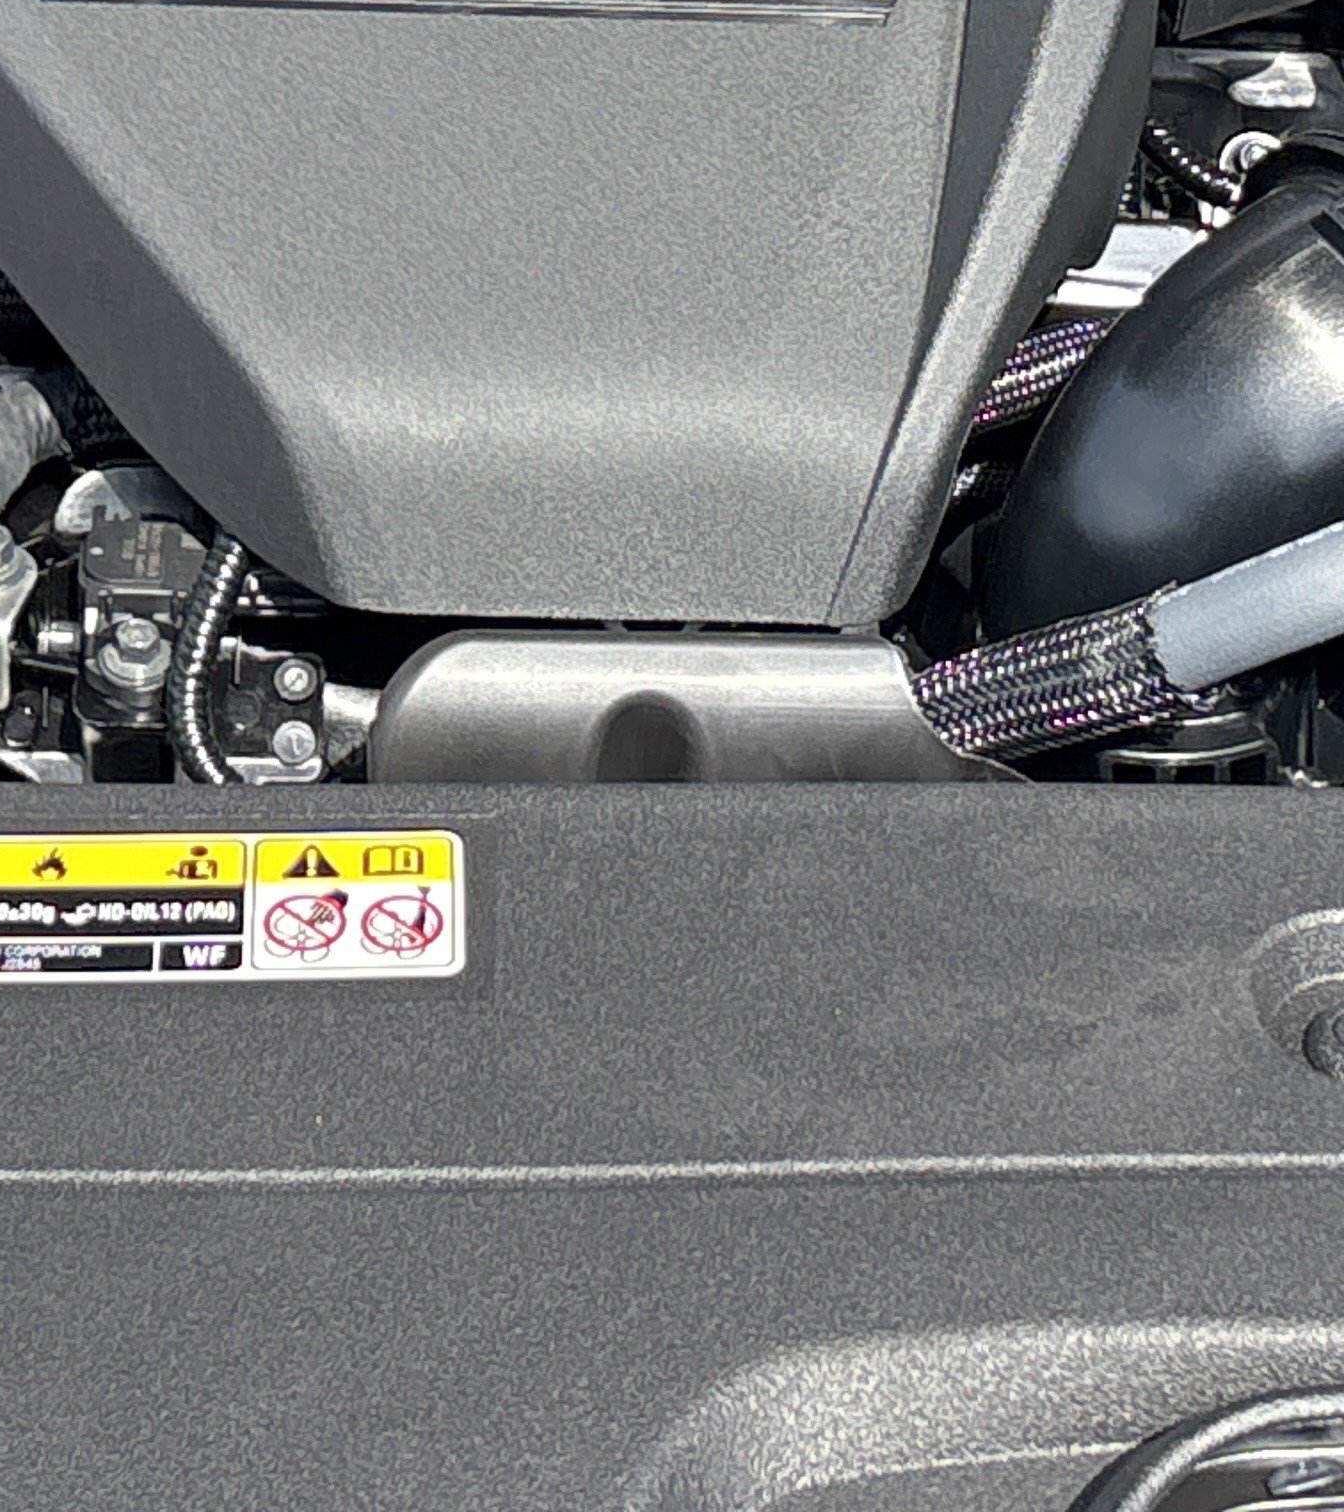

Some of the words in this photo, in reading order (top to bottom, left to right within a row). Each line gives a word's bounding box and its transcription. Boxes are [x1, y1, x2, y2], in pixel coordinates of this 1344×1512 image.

[184, 900, 236, 923] (PAG)
[4, 944, 102, 959] CORPORATION
[182, 944, 227, 968] WF
